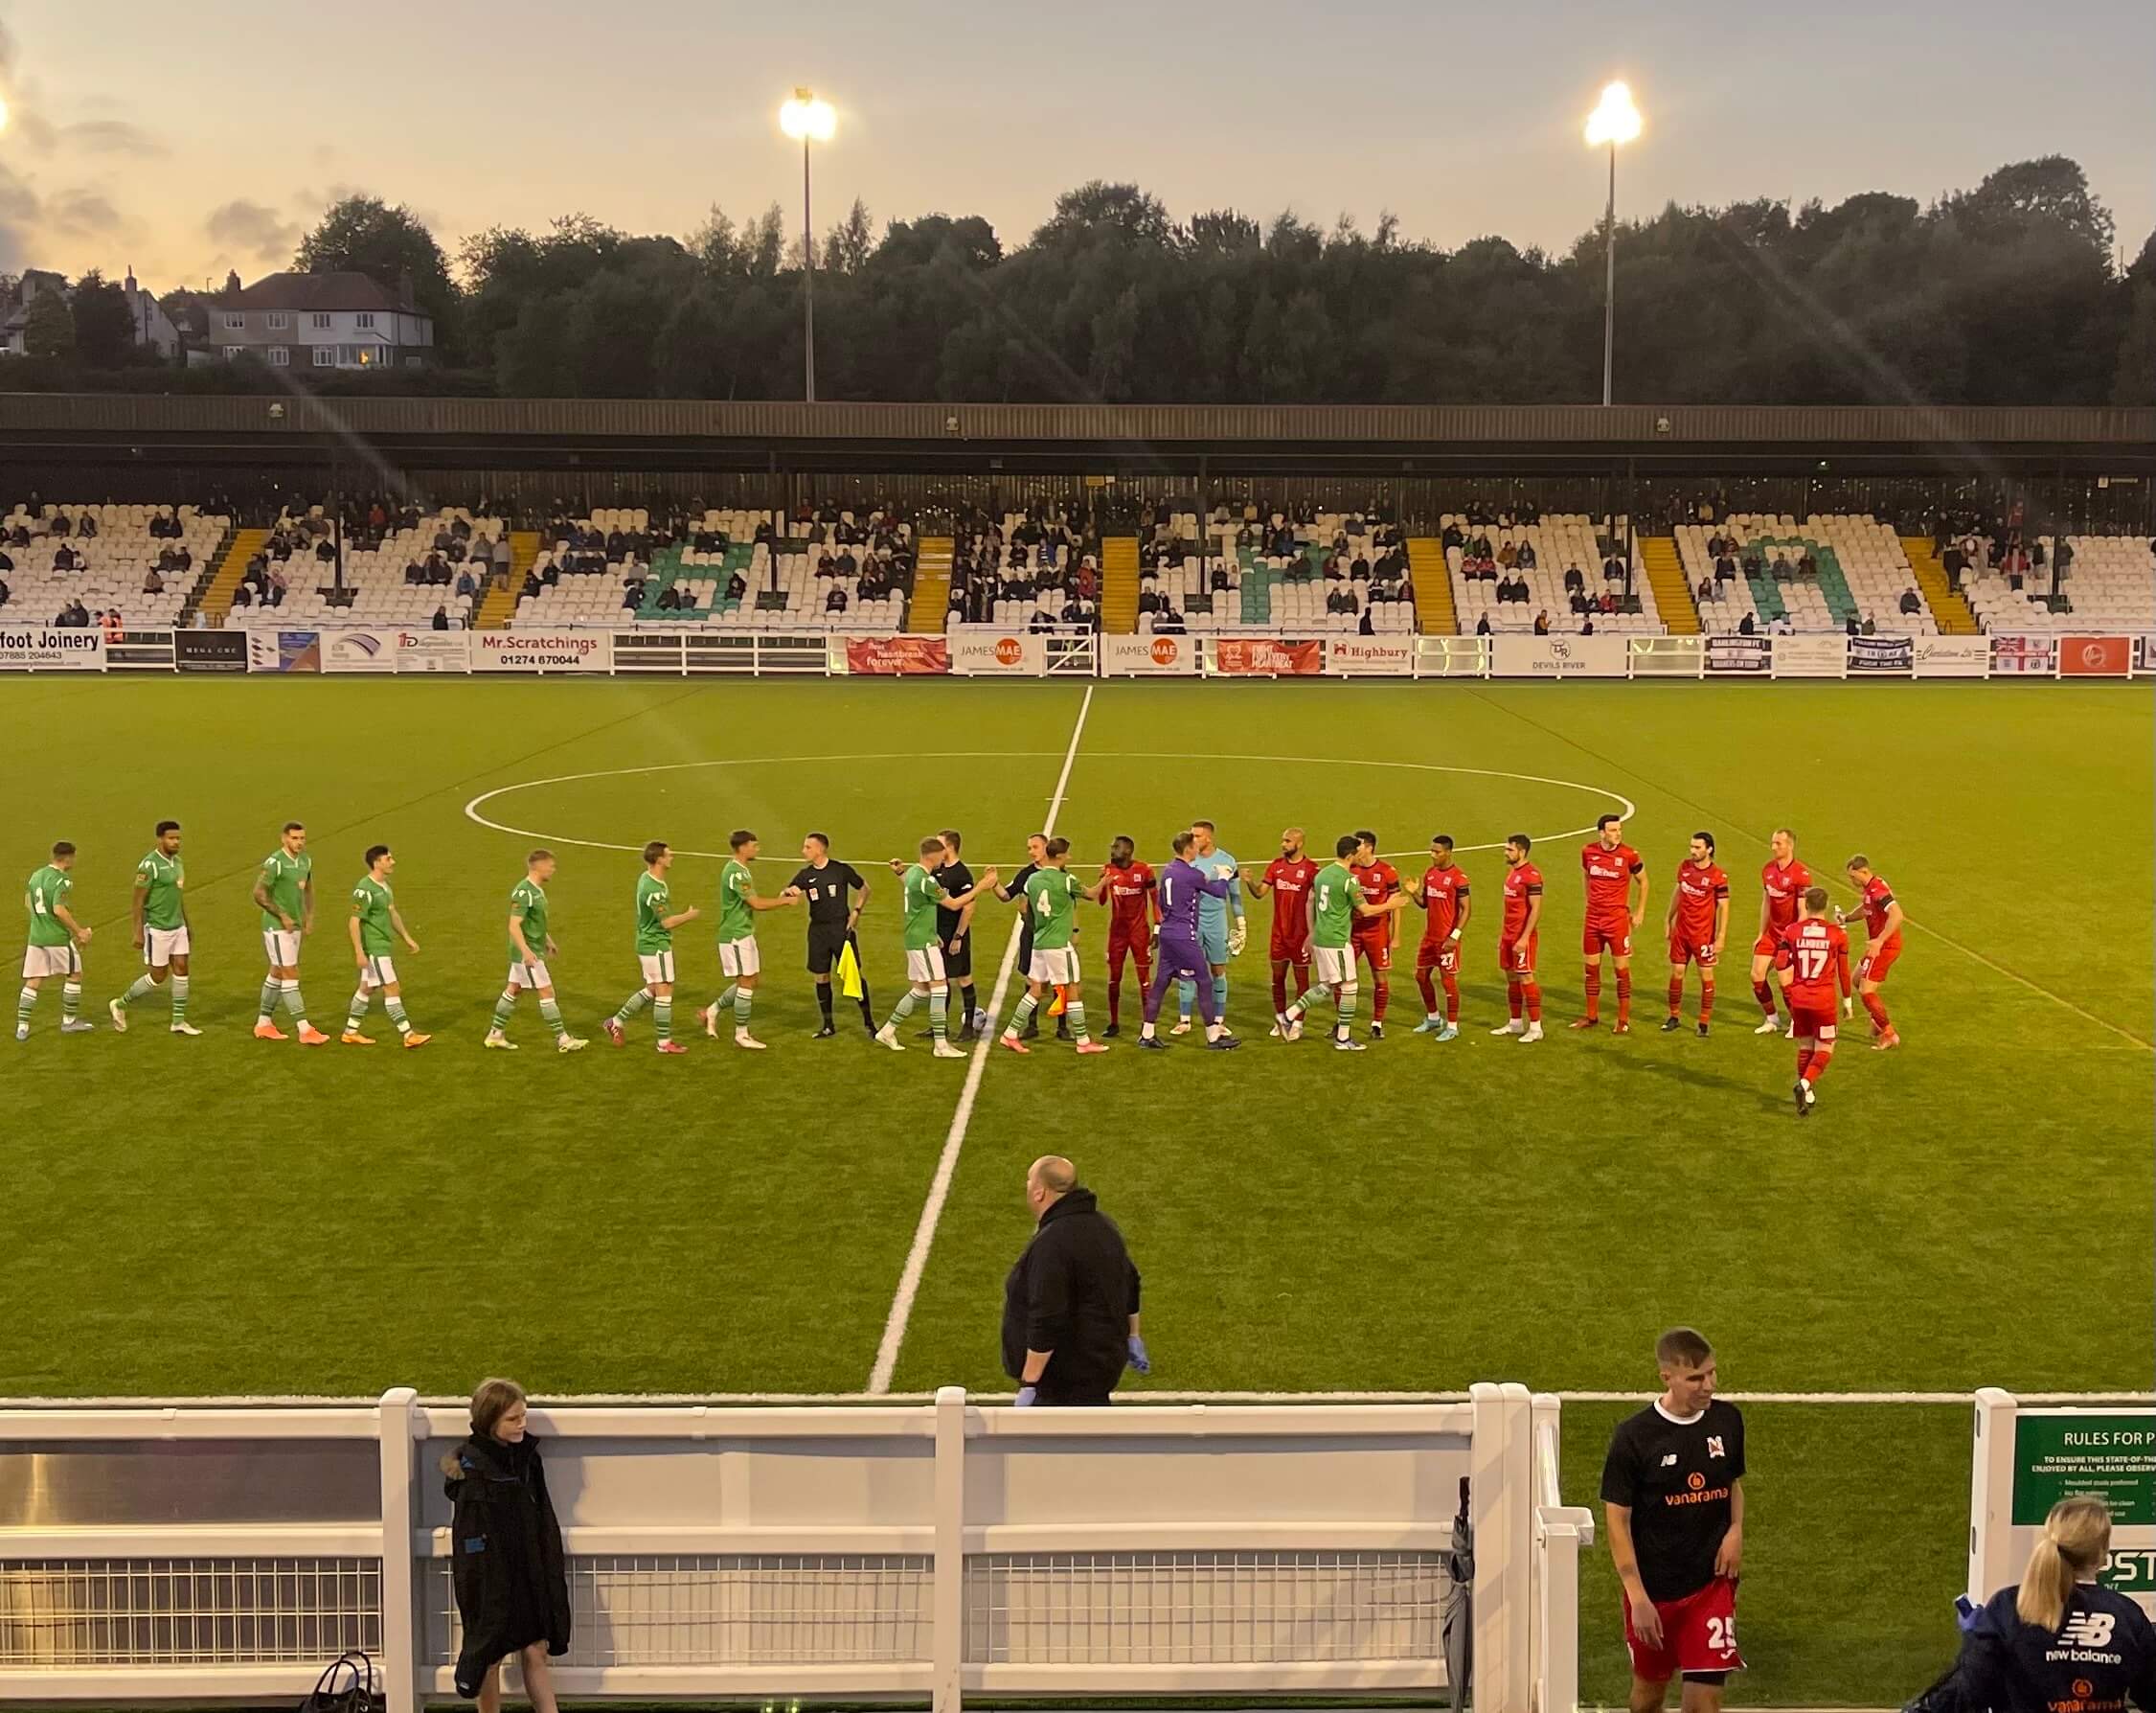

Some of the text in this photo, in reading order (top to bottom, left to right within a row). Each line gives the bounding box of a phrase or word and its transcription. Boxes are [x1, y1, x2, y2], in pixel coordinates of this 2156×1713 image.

[38, 630, 99, 651] Joinery
[482, 636, 598, 655] Mr.Scratchings
[961, 645, 1021, 656] JAMES MAE
[1116, 645, 1177, 656] JAMES MAE
[1351, 647, 1409, 659] Highbury
[500, 655, 535, 665] 01274
[1532, 661, 1561, 670] DEVILS
[1165, 878, 1173, 905] 1
[1318, 884, 1330, 911] 5
[1036, 889, 1052, 917] 4
[1798, 949, 1828, 978] 17
[2064, 1432, 2109, 1446] RULES
[2113, 1431, 2143, 1446] FOR
[2056, 1455, 2086, 1464] ENSURE
[2087, 1455, 2104, 1464] THIS
[1665, 1487, 1729, 1506] vanarama
[1707, 1617, 1737, 1649] 25
[2046, 1649, 2122, 1664] new balance
